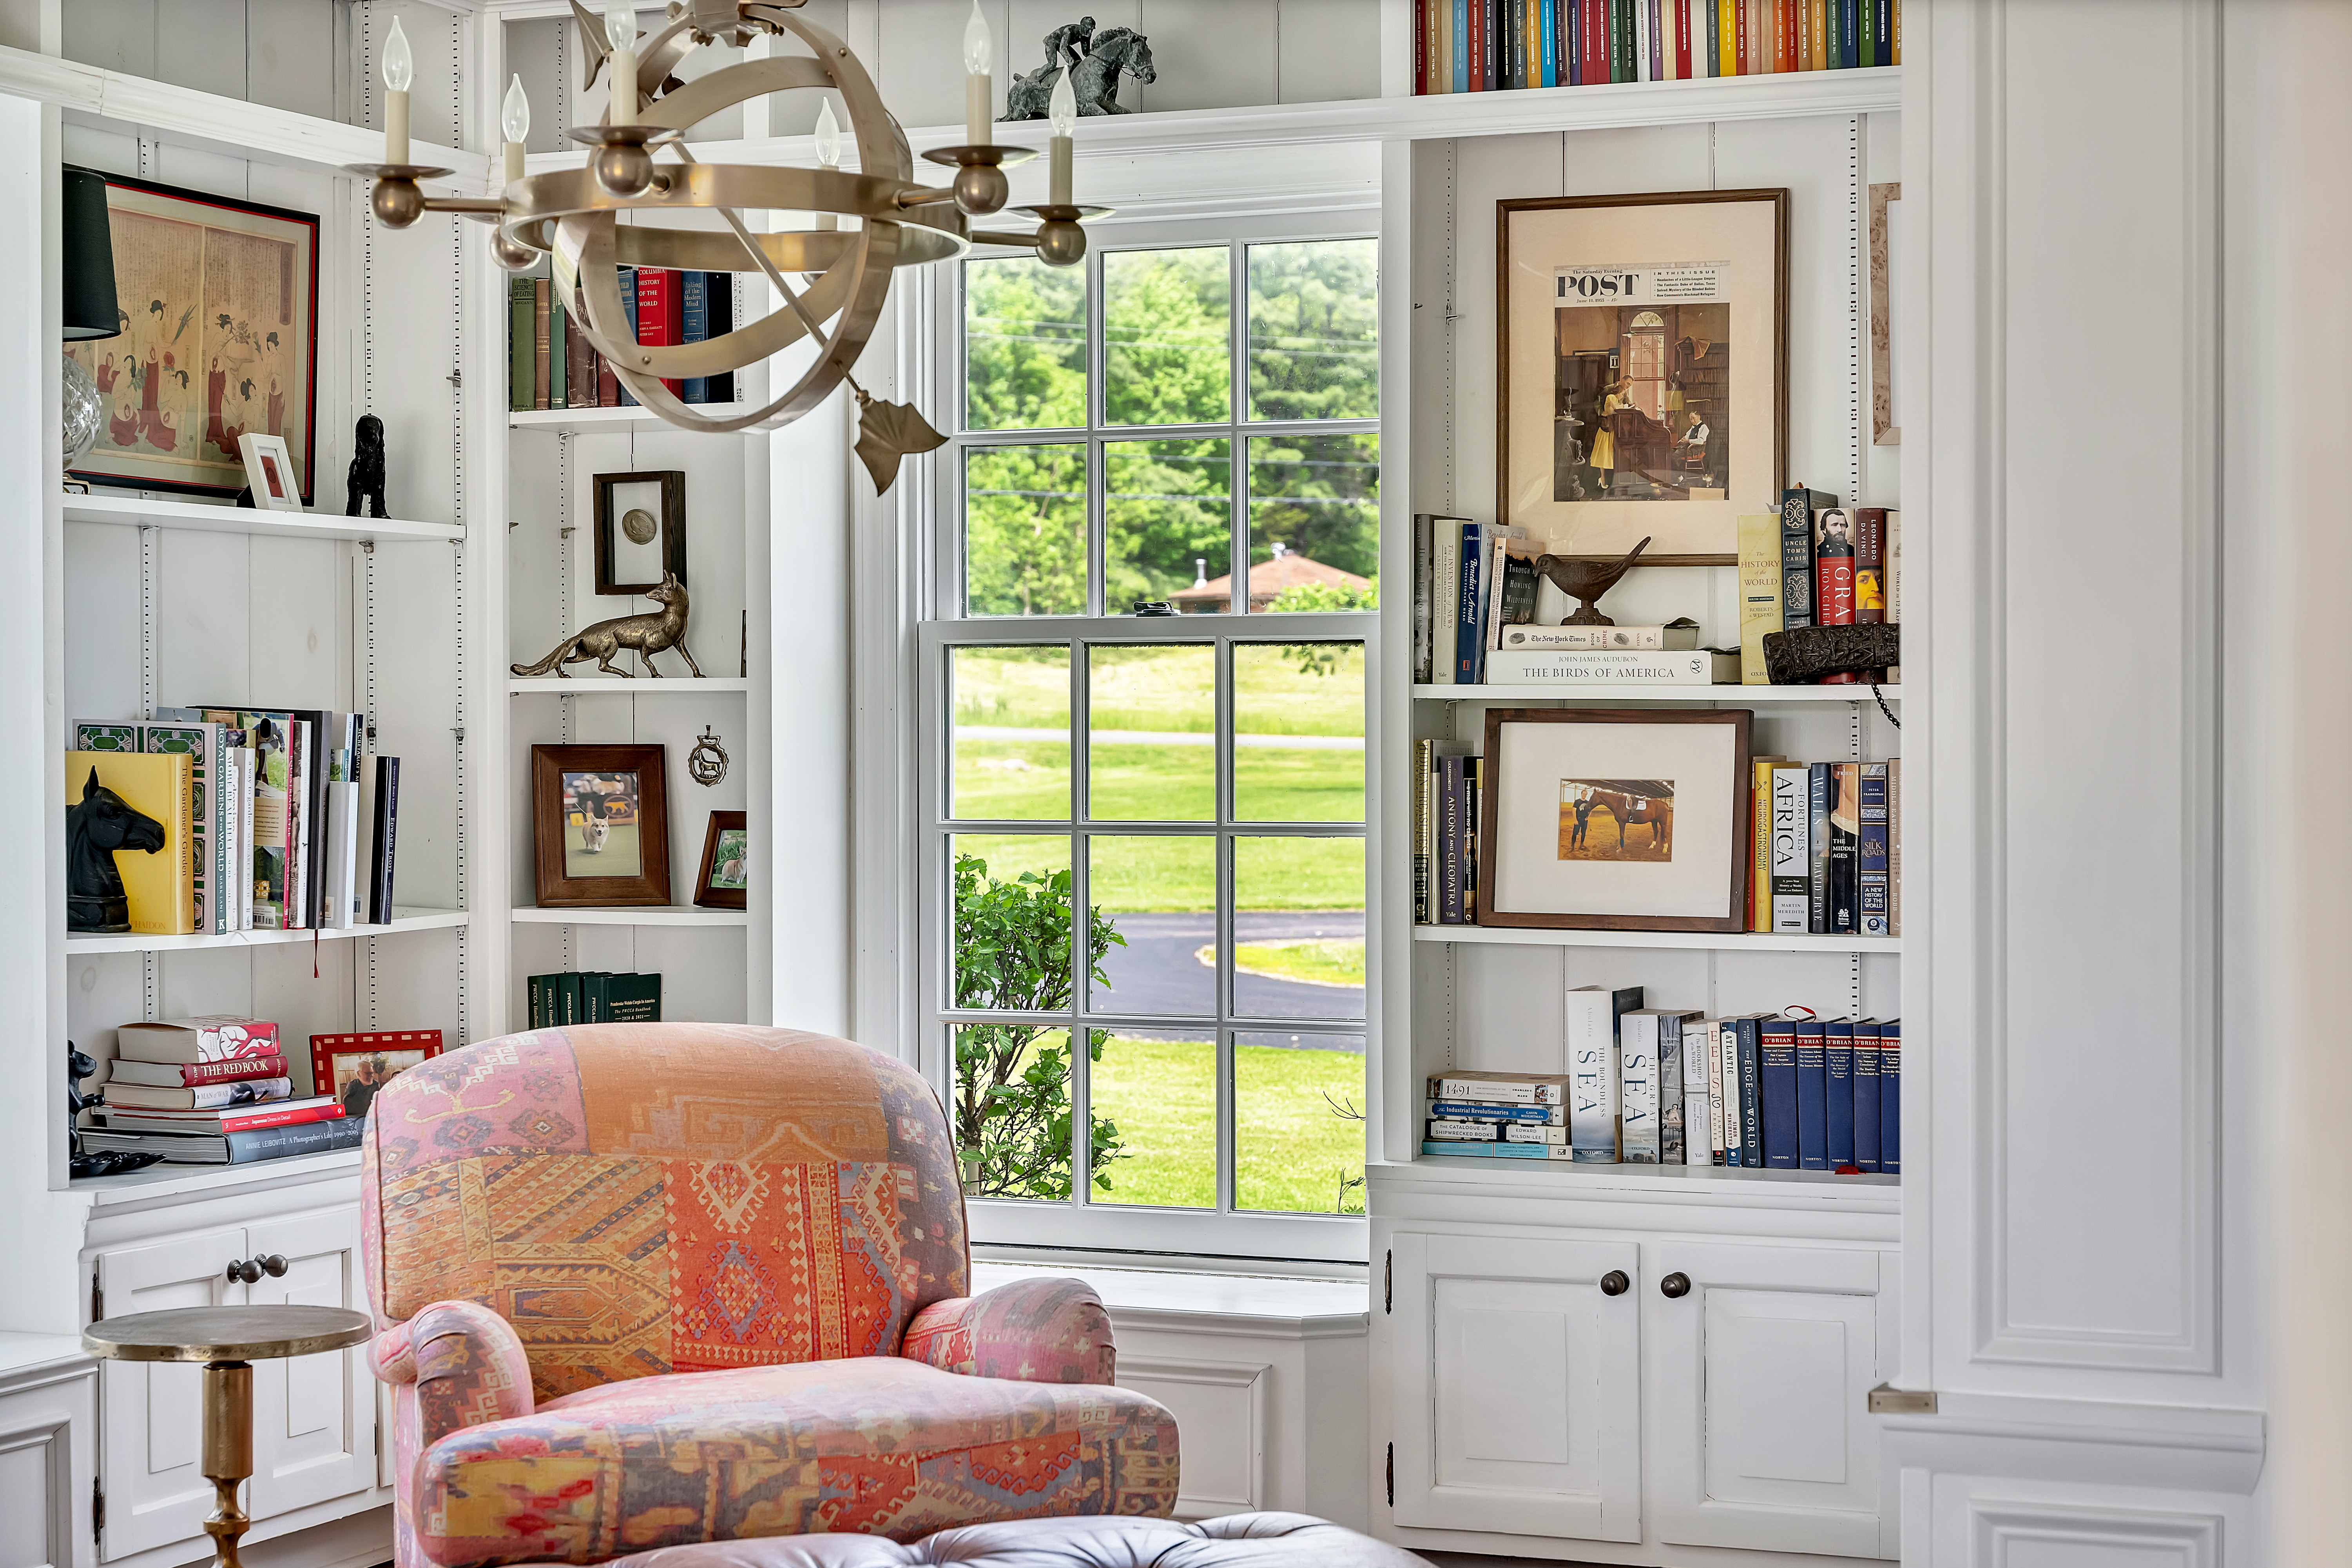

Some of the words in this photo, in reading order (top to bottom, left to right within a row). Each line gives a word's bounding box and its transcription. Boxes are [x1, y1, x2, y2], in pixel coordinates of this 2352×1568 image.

[1555, 275, 1639, 297] POST
[1611, 358, 1618, 366] 11
[1861, 523, 1866, 532] DA
[1509, 564, 1530, 574] THROUGH
[1510, 580, 1531, 589] HOWLING
[1507, 594, 1533, 604] WILDERNESS
[1523, 668, 1548, 677] THE
[1553, 668, 1589, 677] BIRDS
[1595, 668, 1611, 677] OF
[1616, 668, 1674, 678] AMERICA
[1813, 777, 1824, 825] WALLS
[1777, 775, 1794, 866] AFRICA
[1758, 799, 1767, 871] NEUROGASTRONOMY
[130, 921, 166, 930] PHAIDON
[201, 1064, 222, 1077] THE
[223, 1063, 241, 1074] RED
[243, 1060, 268, 1072] BOOK
[1711, 1031, 1719, 1089] EELS
[1578, 1050, 1597, 1113] SEA
[1745, 1060, 1753, 1088] EDGE
[1446, 1083, 1470, 1097] 1491
[1624, 1054, 1647, 1124] SEA
[1747, 1108, 1756, 1148] WORLD
[262, 1139, 286, 1148] LEIBOVITZ
[294, 1133, 323, 1144] Photographer's
